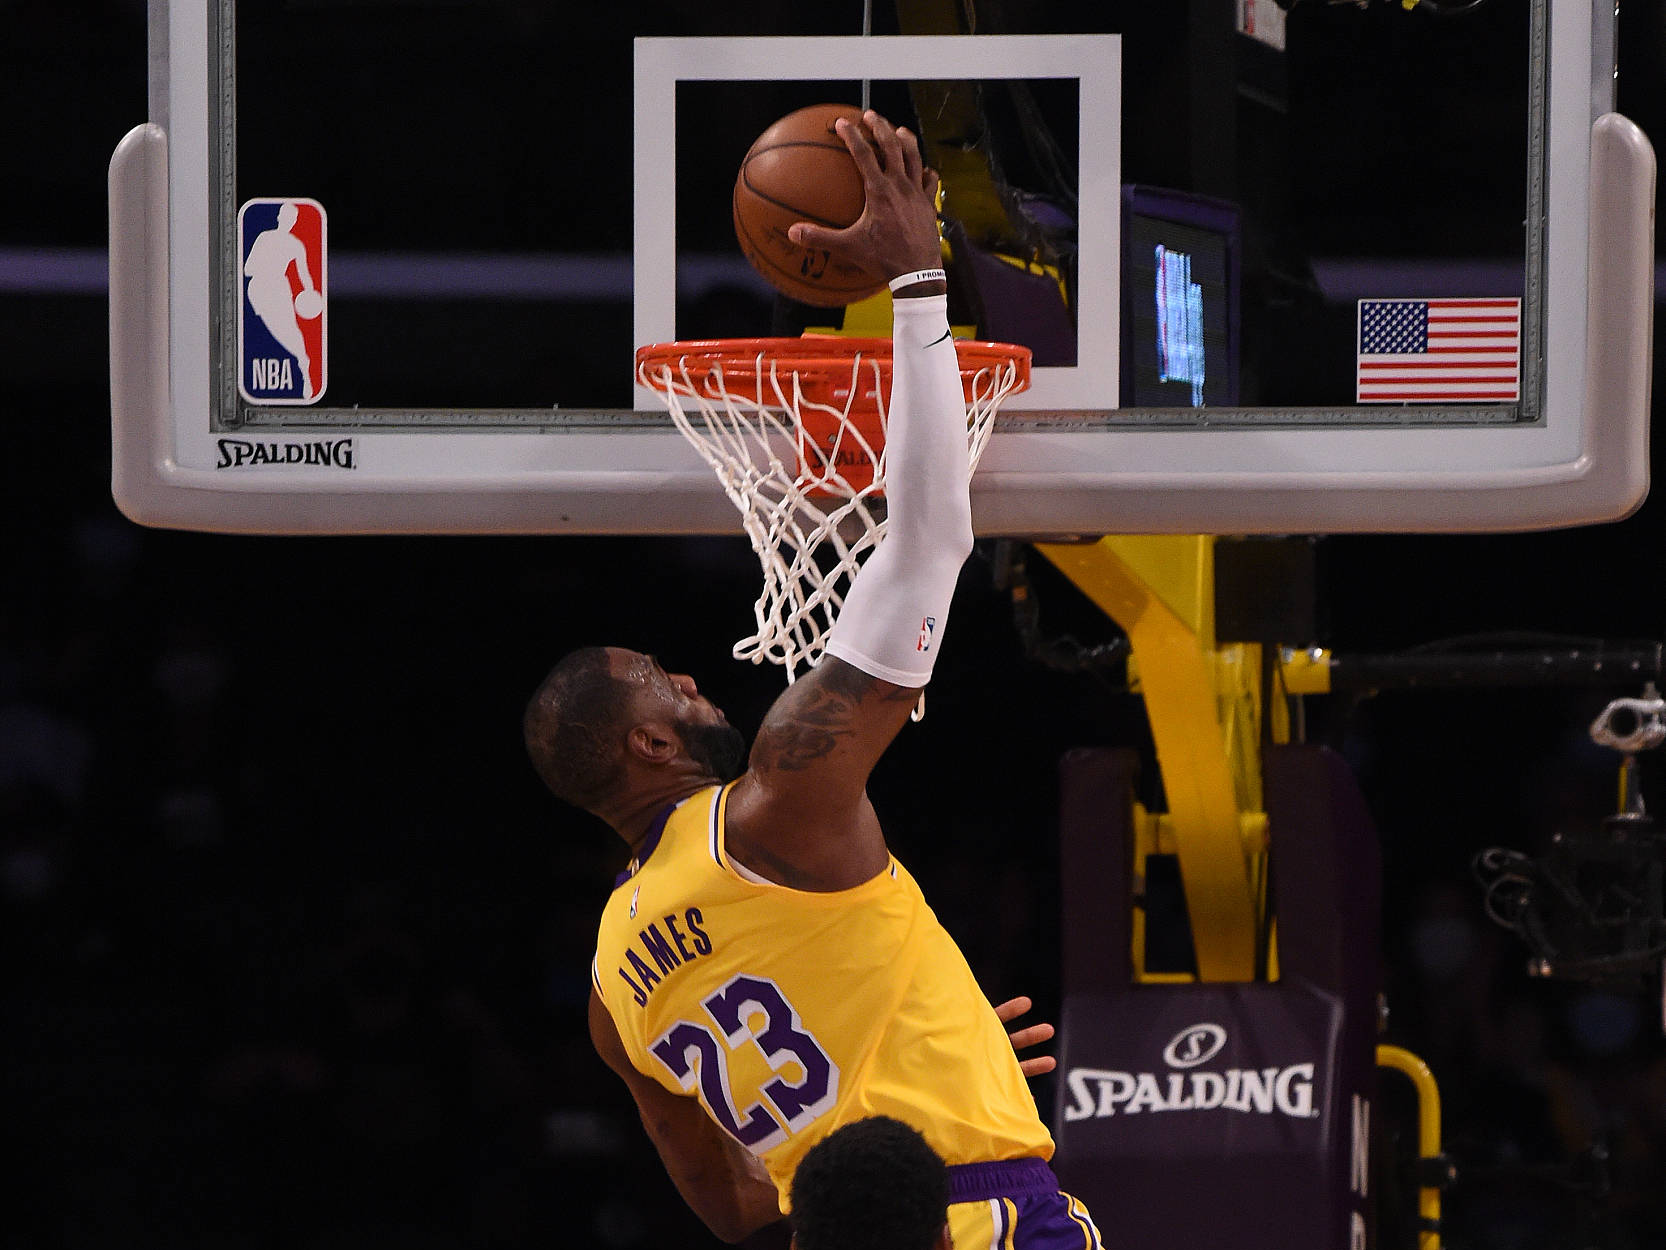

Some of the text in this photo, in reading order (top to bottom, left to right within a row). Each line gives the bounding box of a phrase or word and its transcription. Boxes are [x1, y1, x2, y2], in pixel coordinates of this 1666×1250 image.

[252, 358, 294, 391] NBA
[217, 438, 353, 470] SPALDING
[618, 907, 713, 1008] JAMES
[648, 972, 841, 1156] 23
[1064, 1063, 1316, 1122] SPALDING
